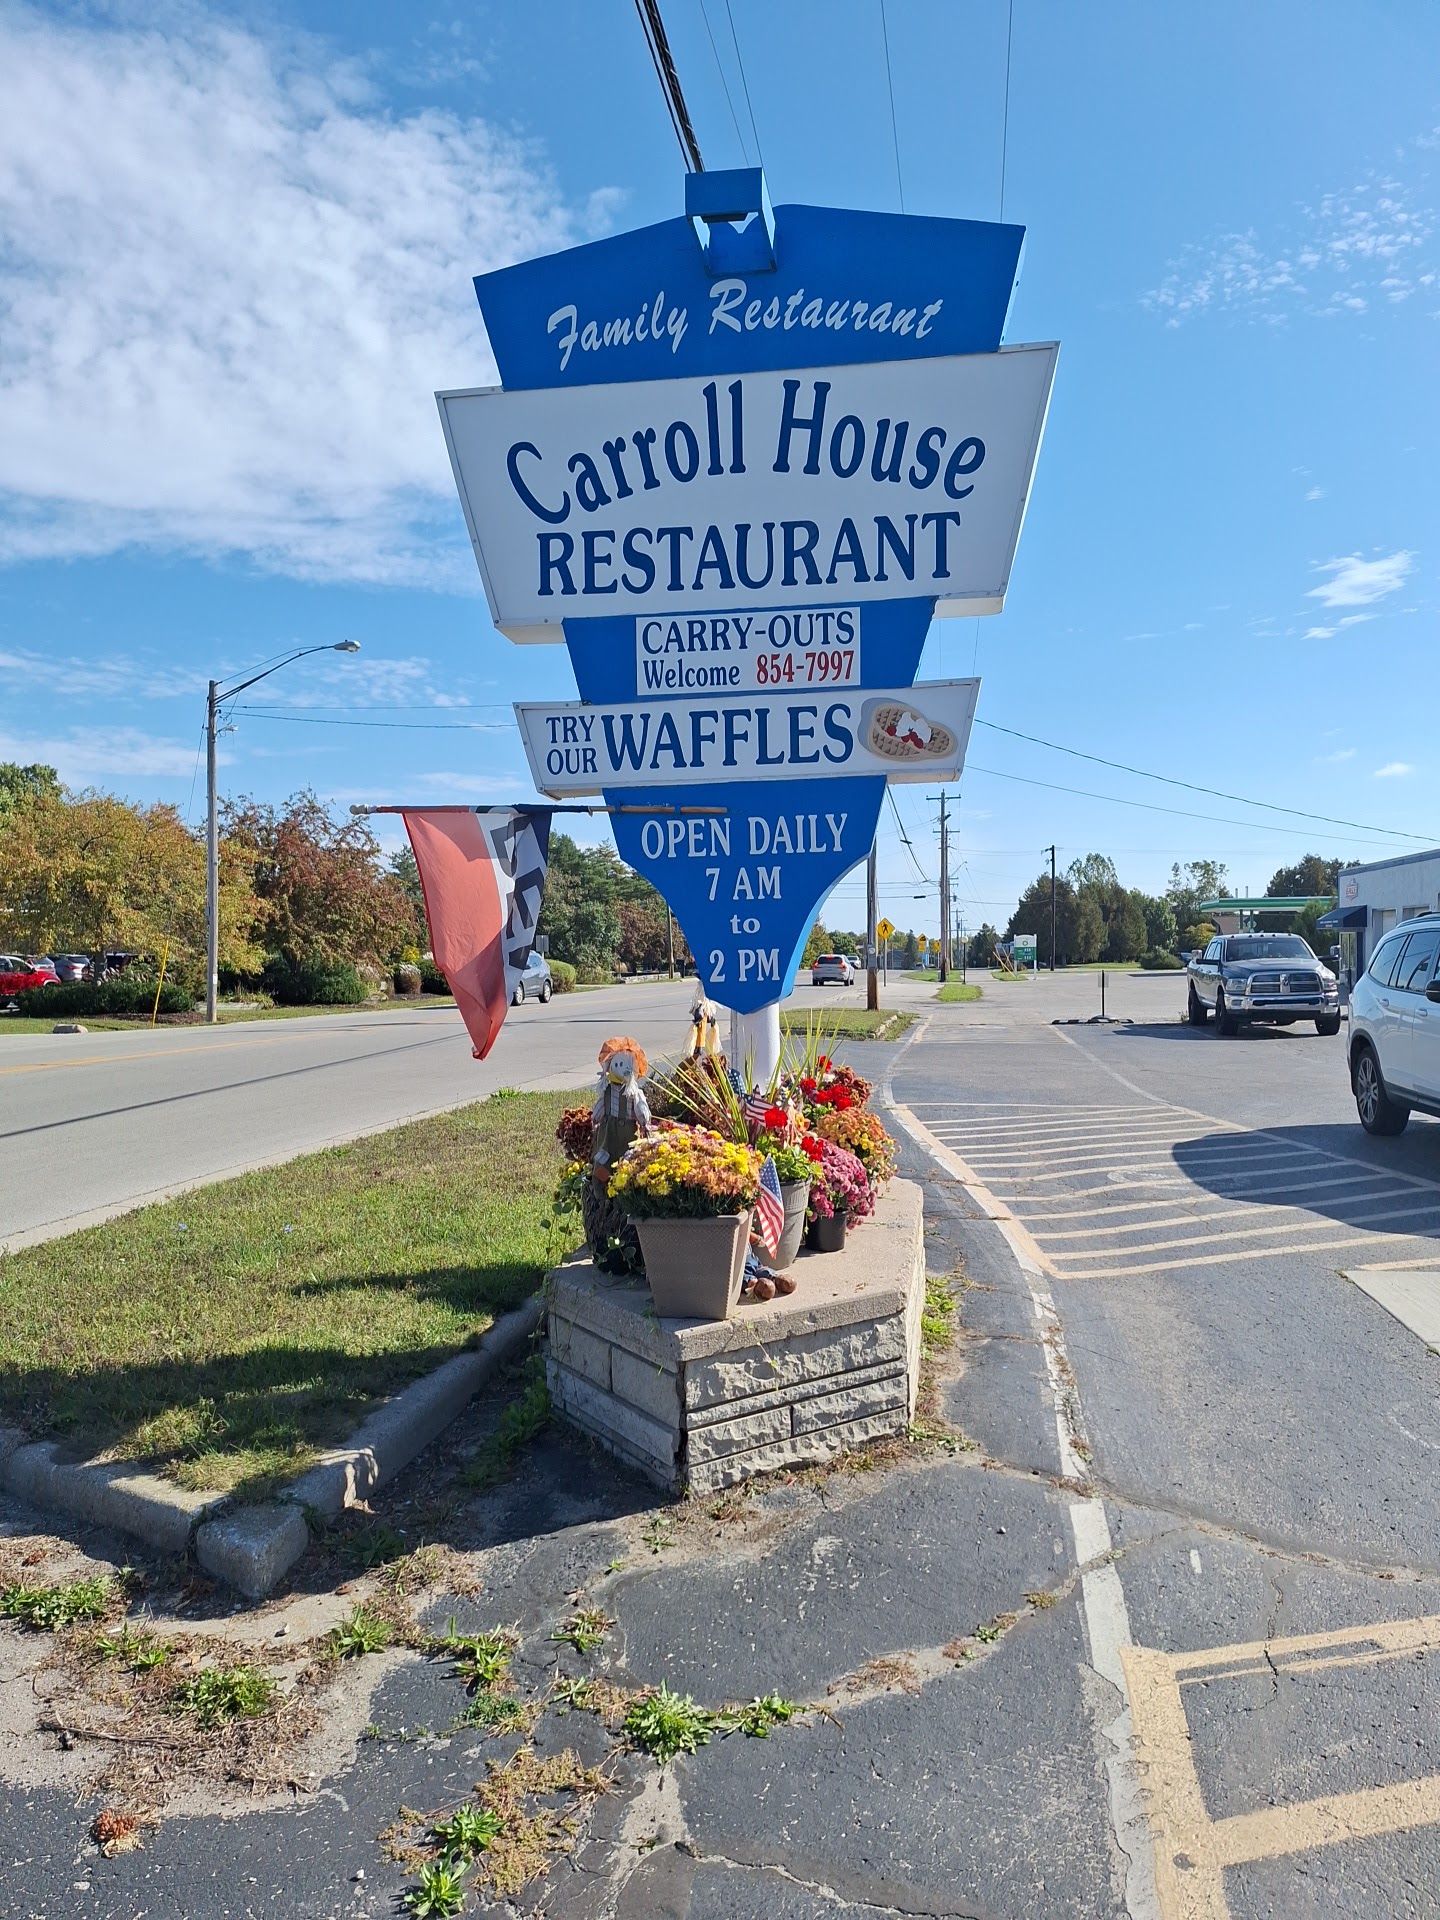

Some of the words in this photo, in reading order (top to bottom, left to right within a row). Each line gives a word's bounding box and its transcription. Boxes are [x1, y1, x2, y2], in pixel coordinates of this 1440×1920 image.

[547, 291, 689, 371] Family
[709, 278, 944, 339] Restaurant
[506, 379, 747, 525] Carroll
[772, 378, 986, 500] House
[537, 511, 961, 597] RESTAURANT
[641, 610, 855, 655] CARRY-OUTS
[643, 658, 741, 689] Welcome
[756, 650, 855, 685] 854-7997
[545, 714, 596, 744] TRY
[601, 703, 854, 772] WAFFLES
[546, 747, 598, 776] OUR
[641, 818, 731, 859] OPEN
[748, 813, 848, 855] DAILY
[705, 867, 720, 902] 7
[732, 866, 782, 900] AM
[729, 914, 761, 934] to
[709, 950, 726, 983] 2
[737, 948, 781, 982] PM
